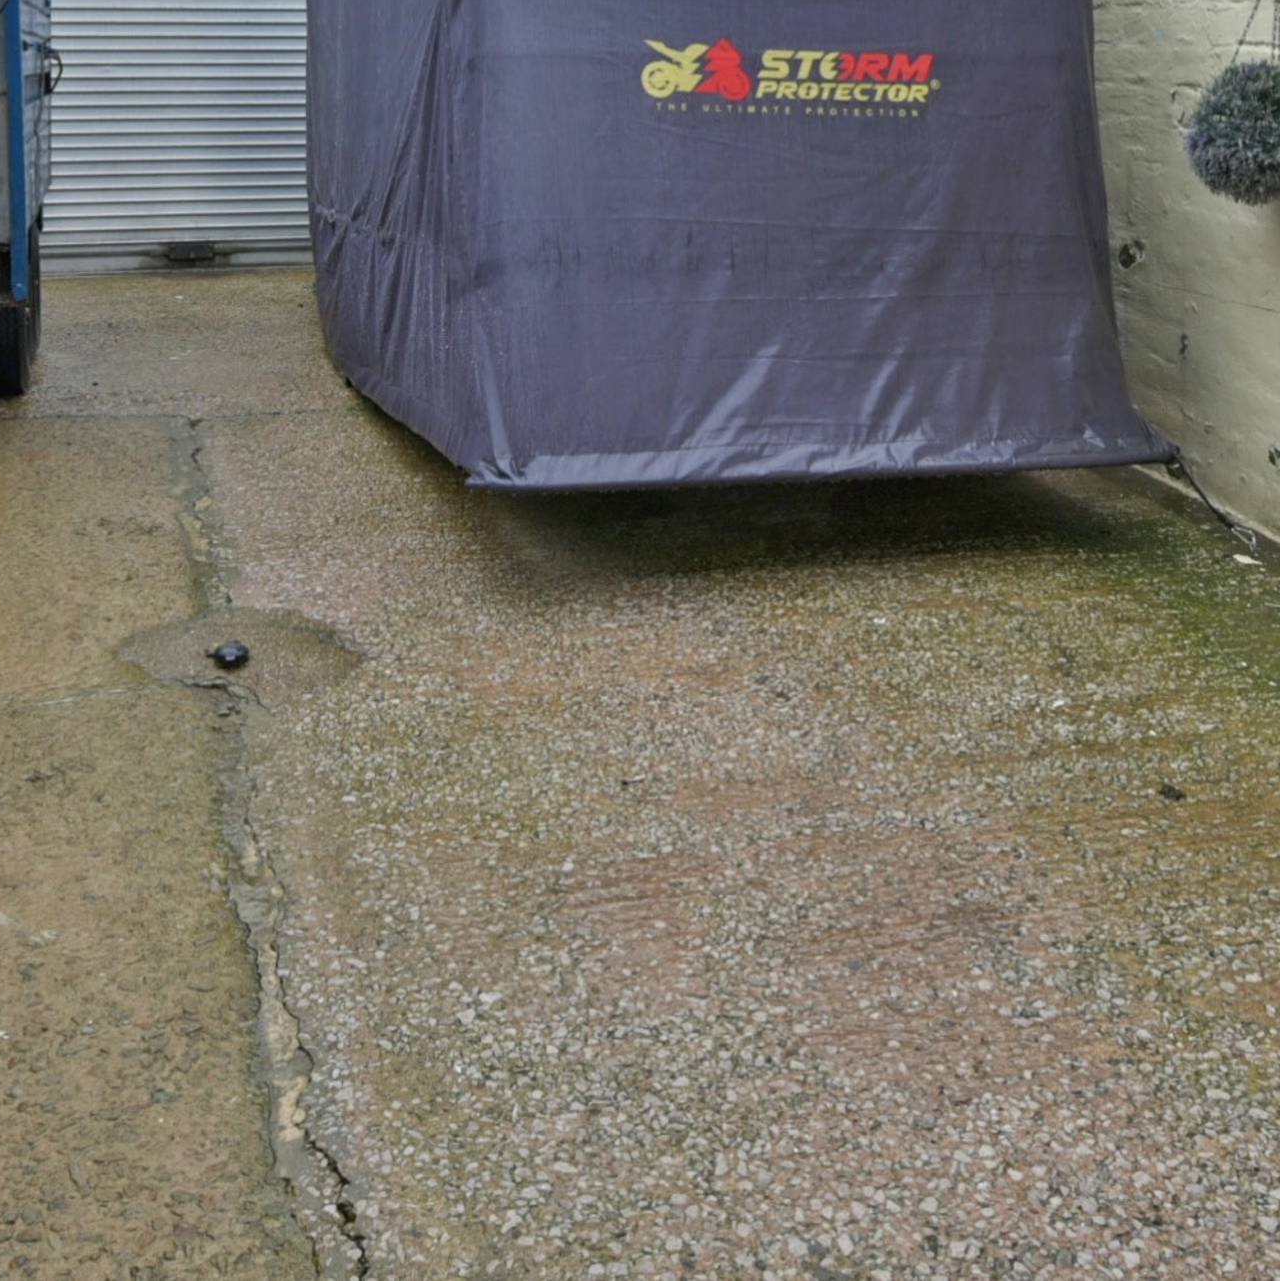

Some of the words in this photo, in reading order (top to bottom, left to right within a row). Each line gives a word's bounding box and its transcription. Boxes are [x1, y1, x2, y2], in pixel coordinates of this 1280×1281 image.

[757, 49, 934, 82] STORM
[656, 102, 688, 112] THE
[702, 104, 792, 116] ULTIMATE
[805, 106, 920, 118] PROTECTION
